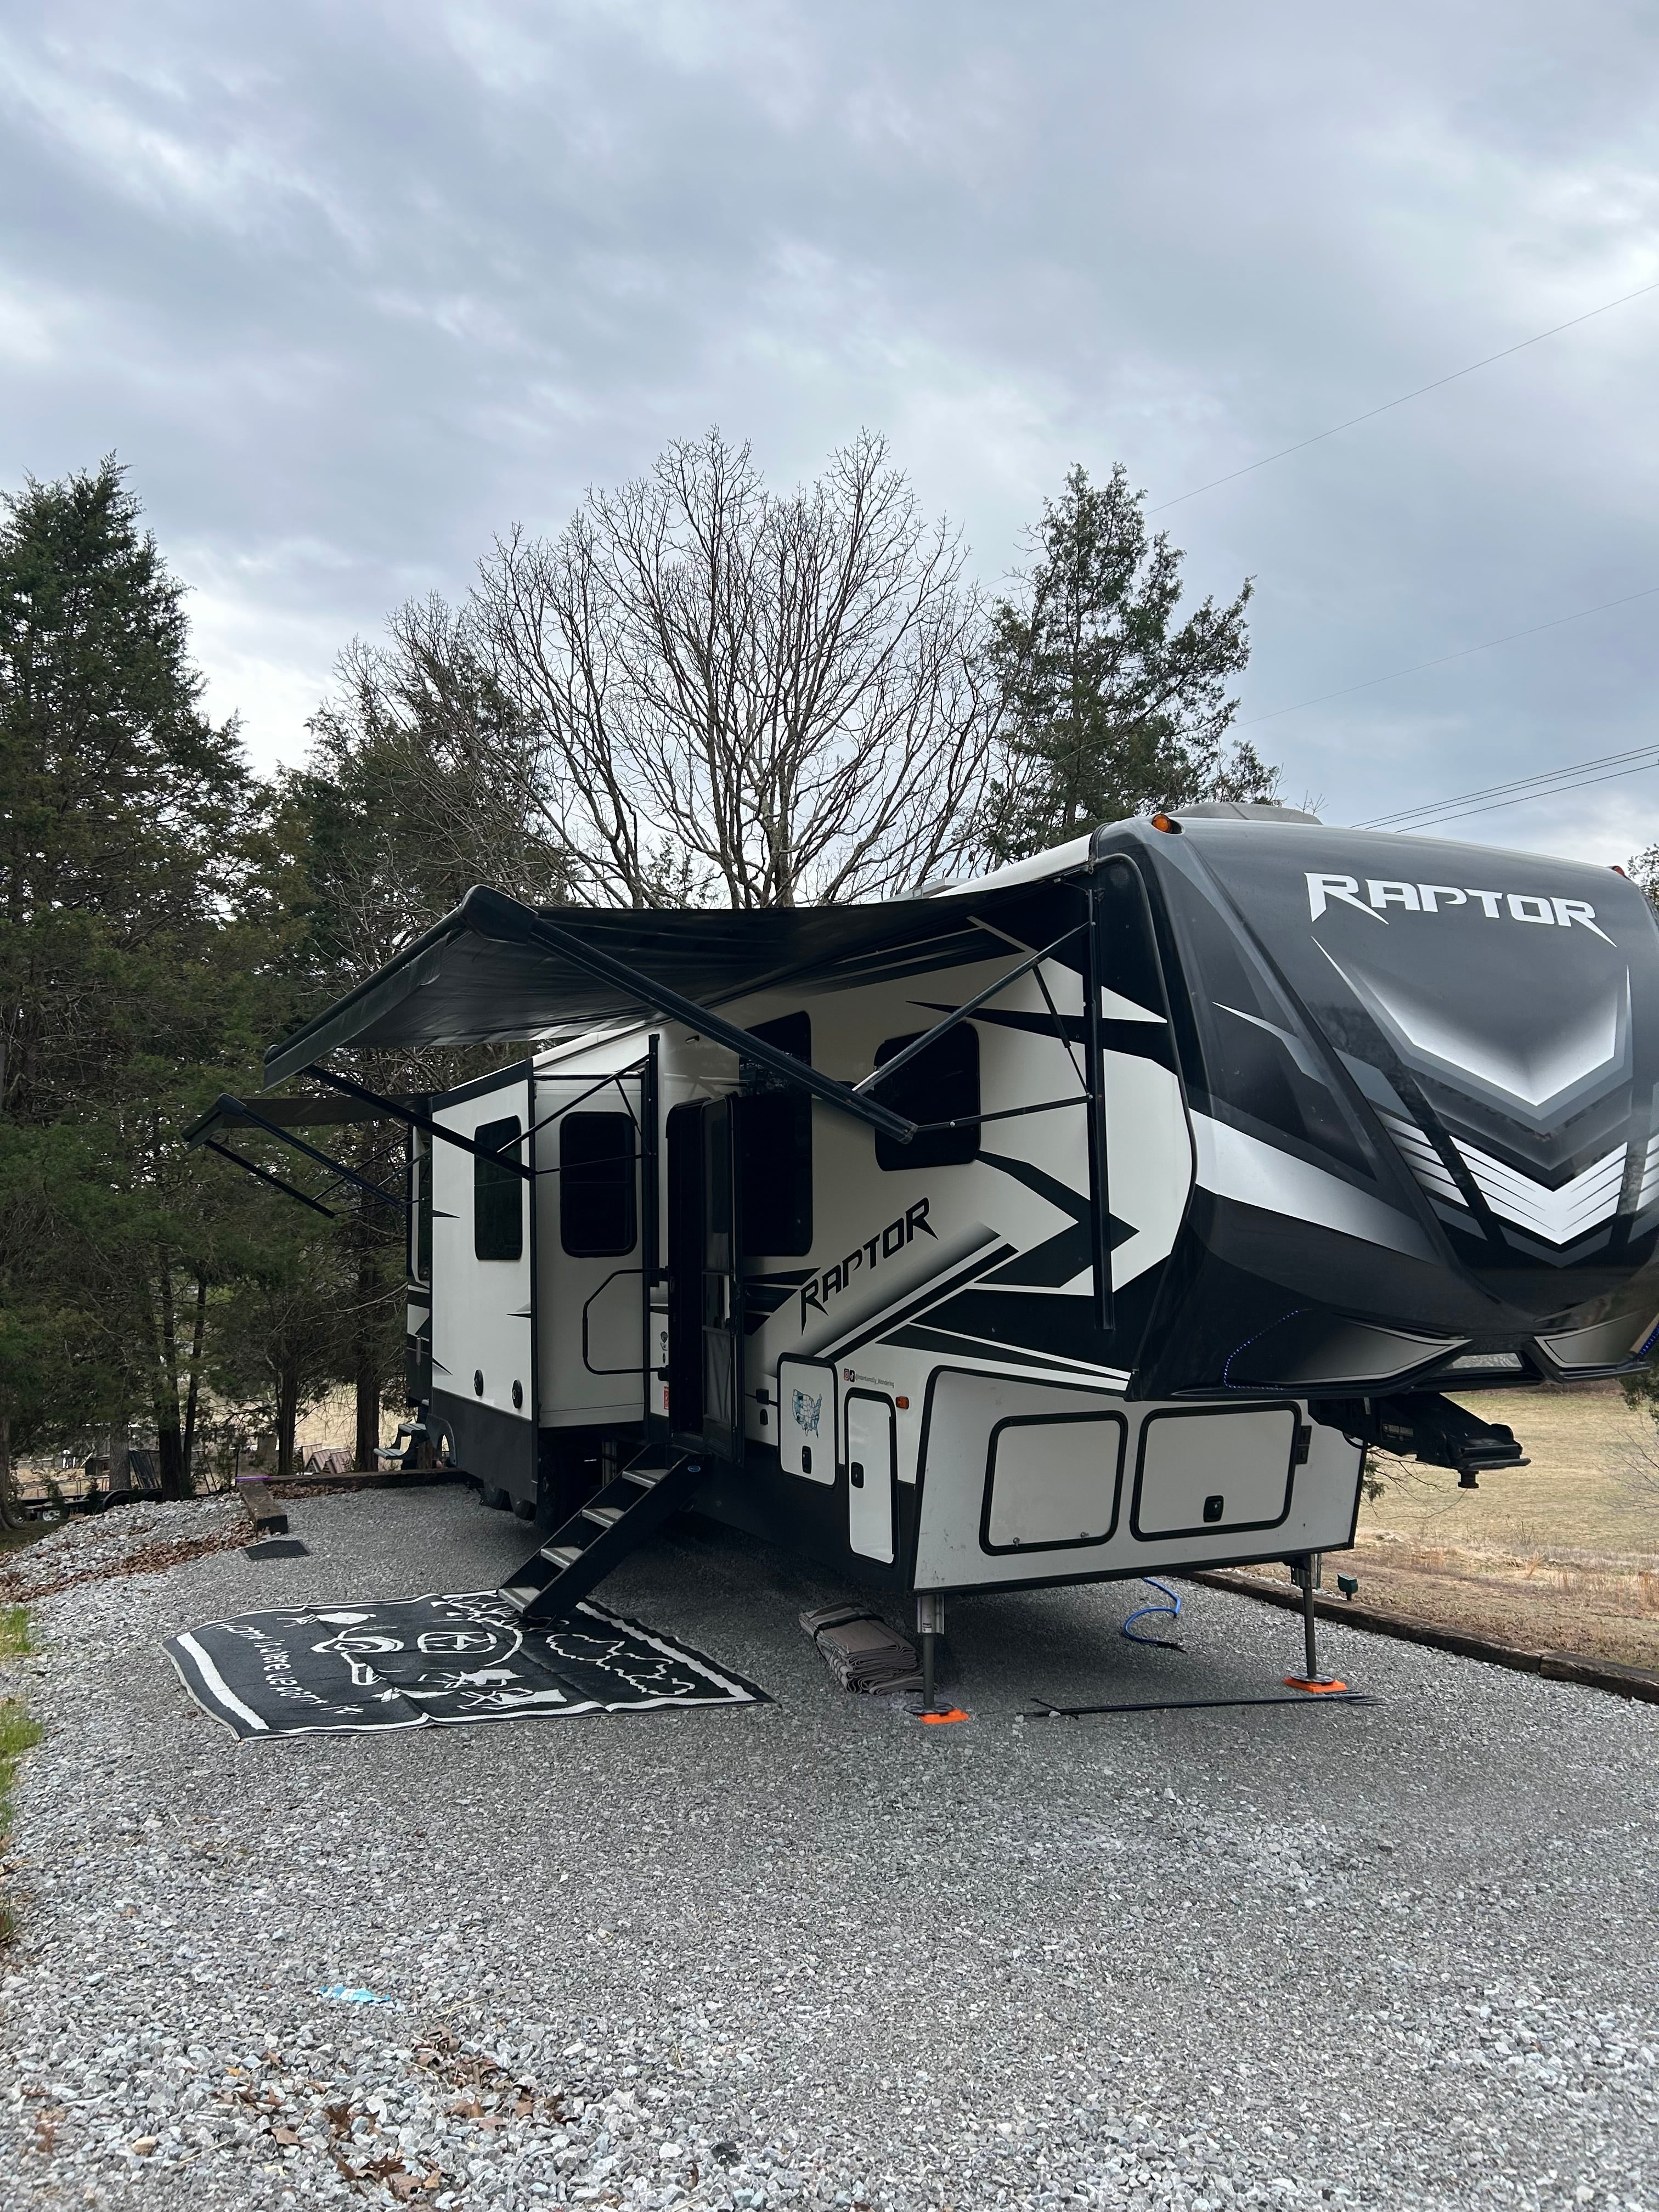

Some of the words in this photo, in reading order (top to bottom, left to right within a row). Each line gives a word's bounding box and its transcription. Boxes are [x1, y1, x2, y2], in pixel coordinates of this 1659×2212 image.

[1304, 872, 1617, 947] RAPTOR
[801, 1197, 939, 1335] RAPTOR
[266, 1672, 298, 1686] we
